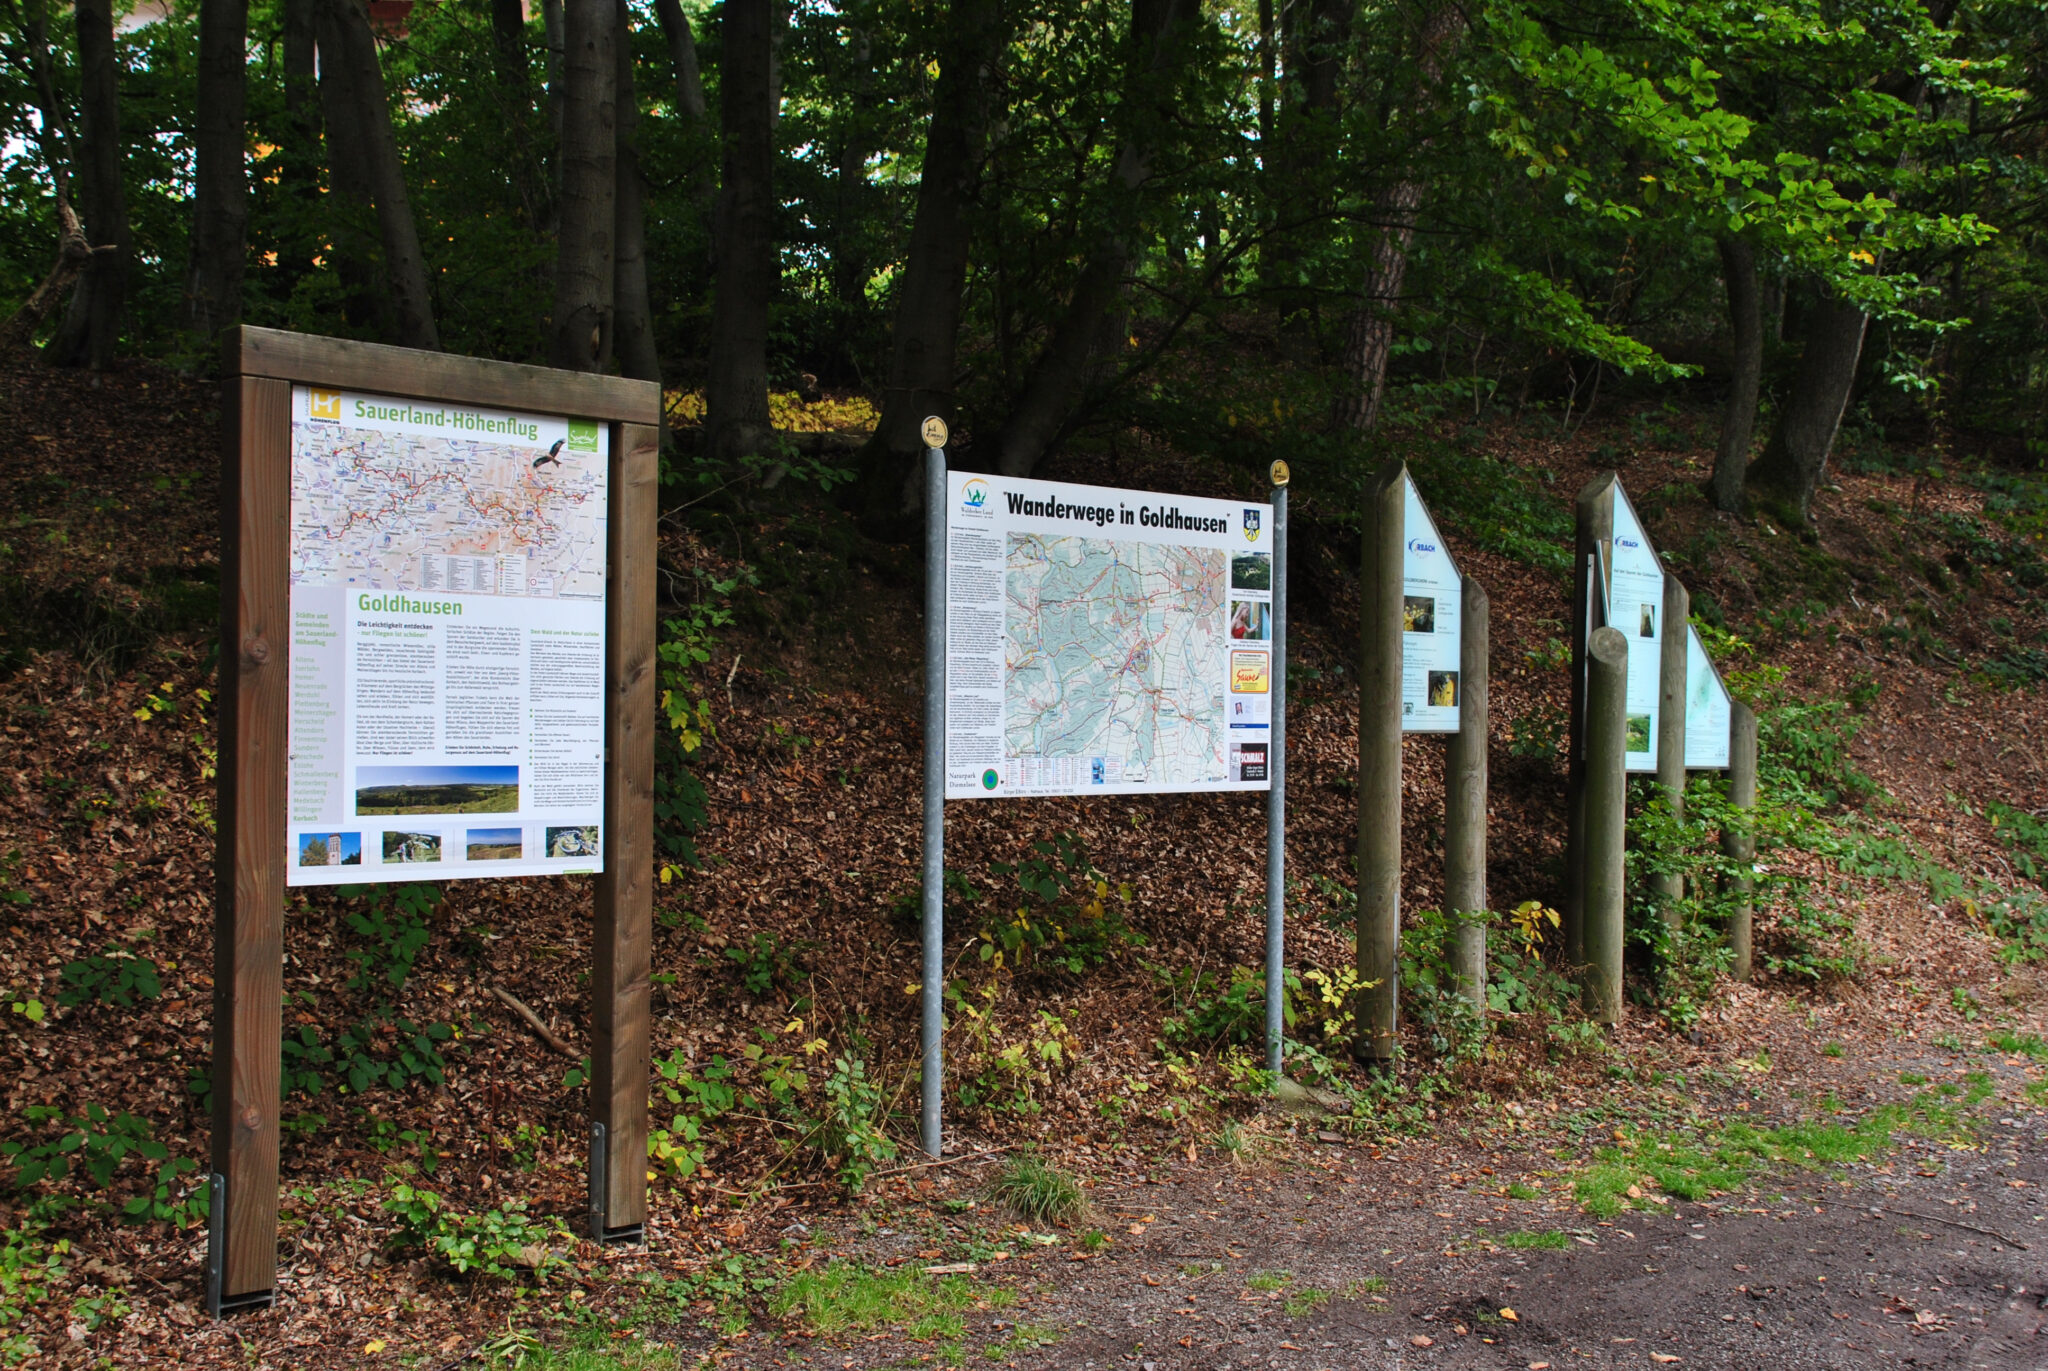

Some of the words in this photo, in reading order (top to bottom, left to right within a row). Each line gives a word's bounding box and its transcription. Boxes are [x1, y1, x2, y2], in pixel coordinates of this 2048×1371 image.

[355, 400, 539, 442] Sauerland-Höhenflug
[1007, 492, 1115, 527] Wanderwege
[1120, 503, 1134, 525] in
[1139, 505, 1227, 533] Goldhausen
[358, 594, 463, 616] Goldhausen
